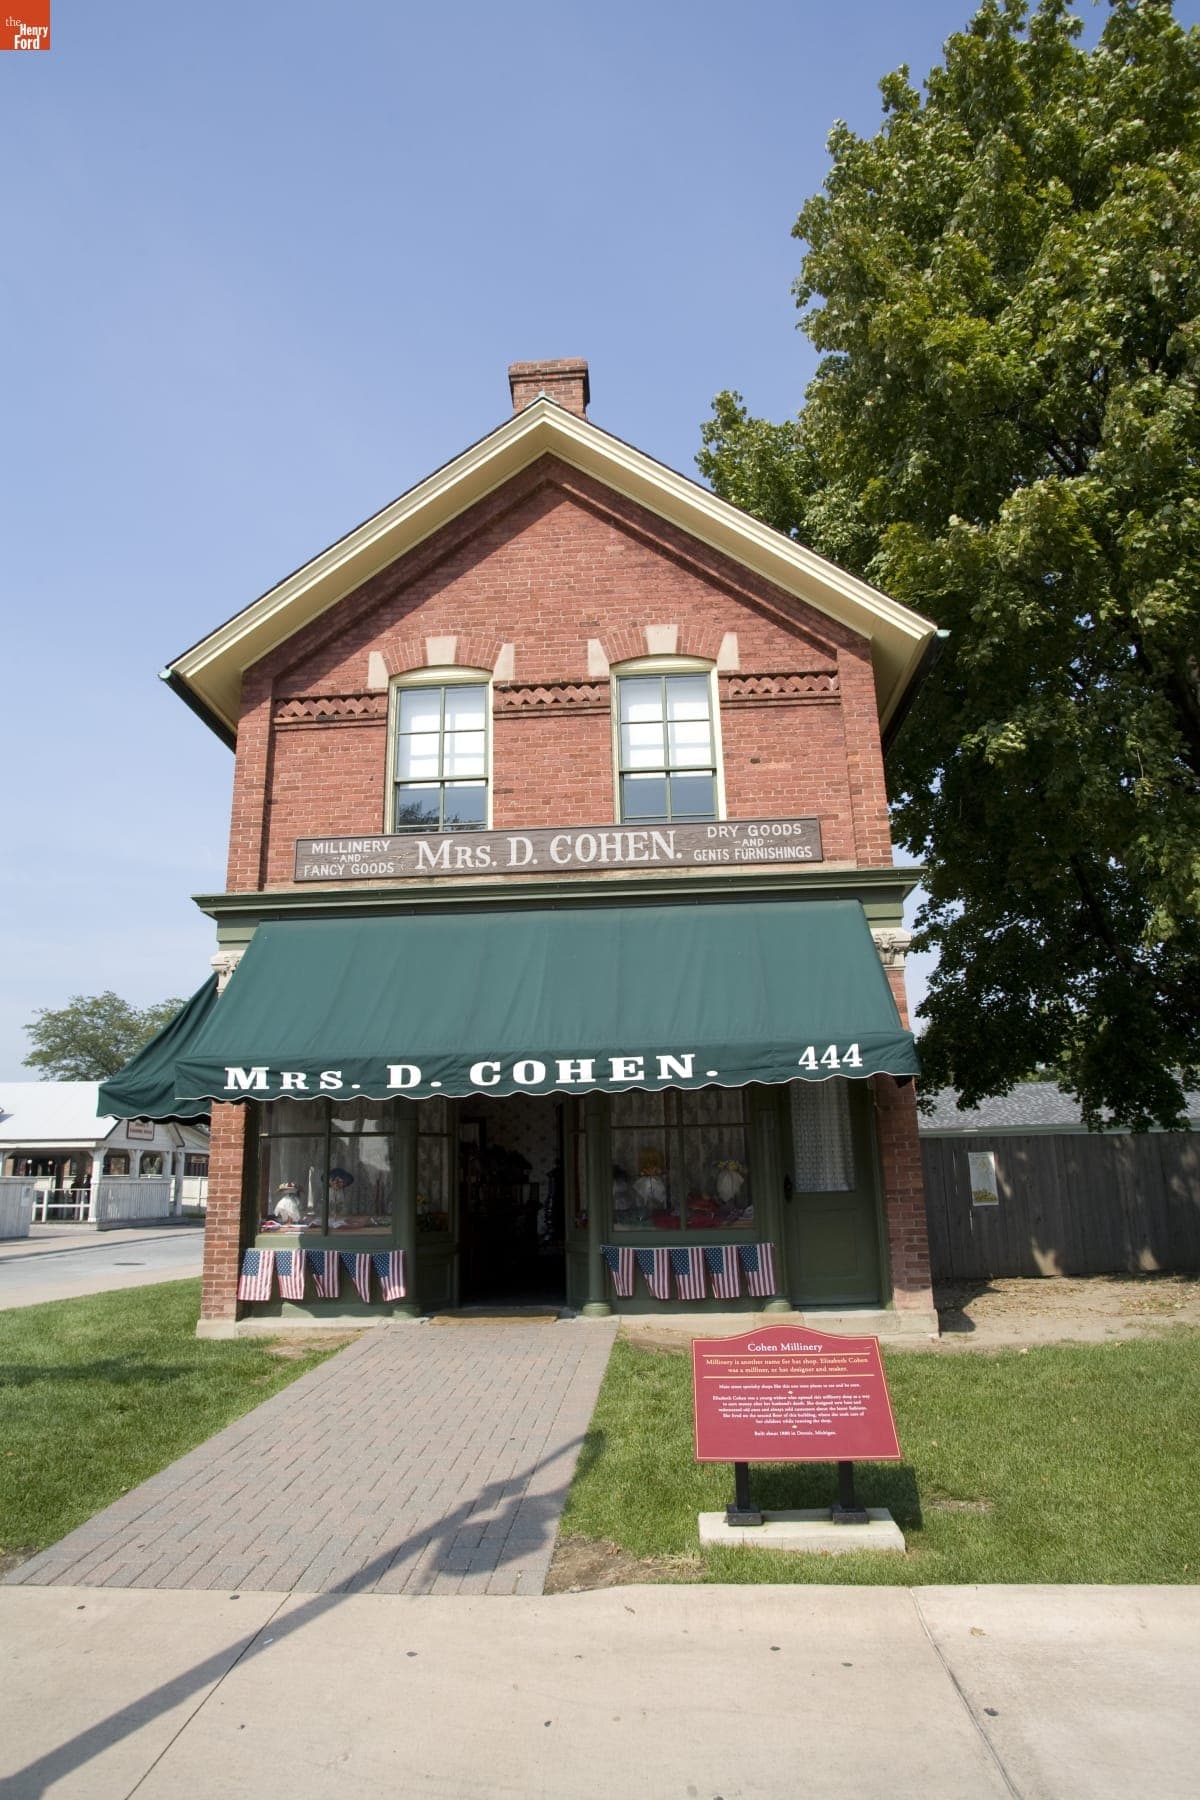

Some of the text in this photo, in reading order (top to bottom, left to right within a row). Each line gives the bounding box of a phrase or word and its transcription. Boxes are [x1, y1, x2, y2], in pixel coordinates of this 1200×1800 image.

[707, 823, 802, 838] DRY GOODS
[312, 840, 391, 854] MILLINERY
[506, 836, 538, 866] D.
[550, 830, 682, 864] COHEN.
[693, 846, 813, 861] GENTS FURNISHINGS
[304, 862, 395, 877] FANCY GOODS
[798, 1043, 863, 1070] 444
[386, 1064, 442, 1089] D.
[469, 1053, 718, 1086] COHEN.
[747, 1342, 823, 1352] Cohen Millinery
[790, 1366, 814, 1374] designer
